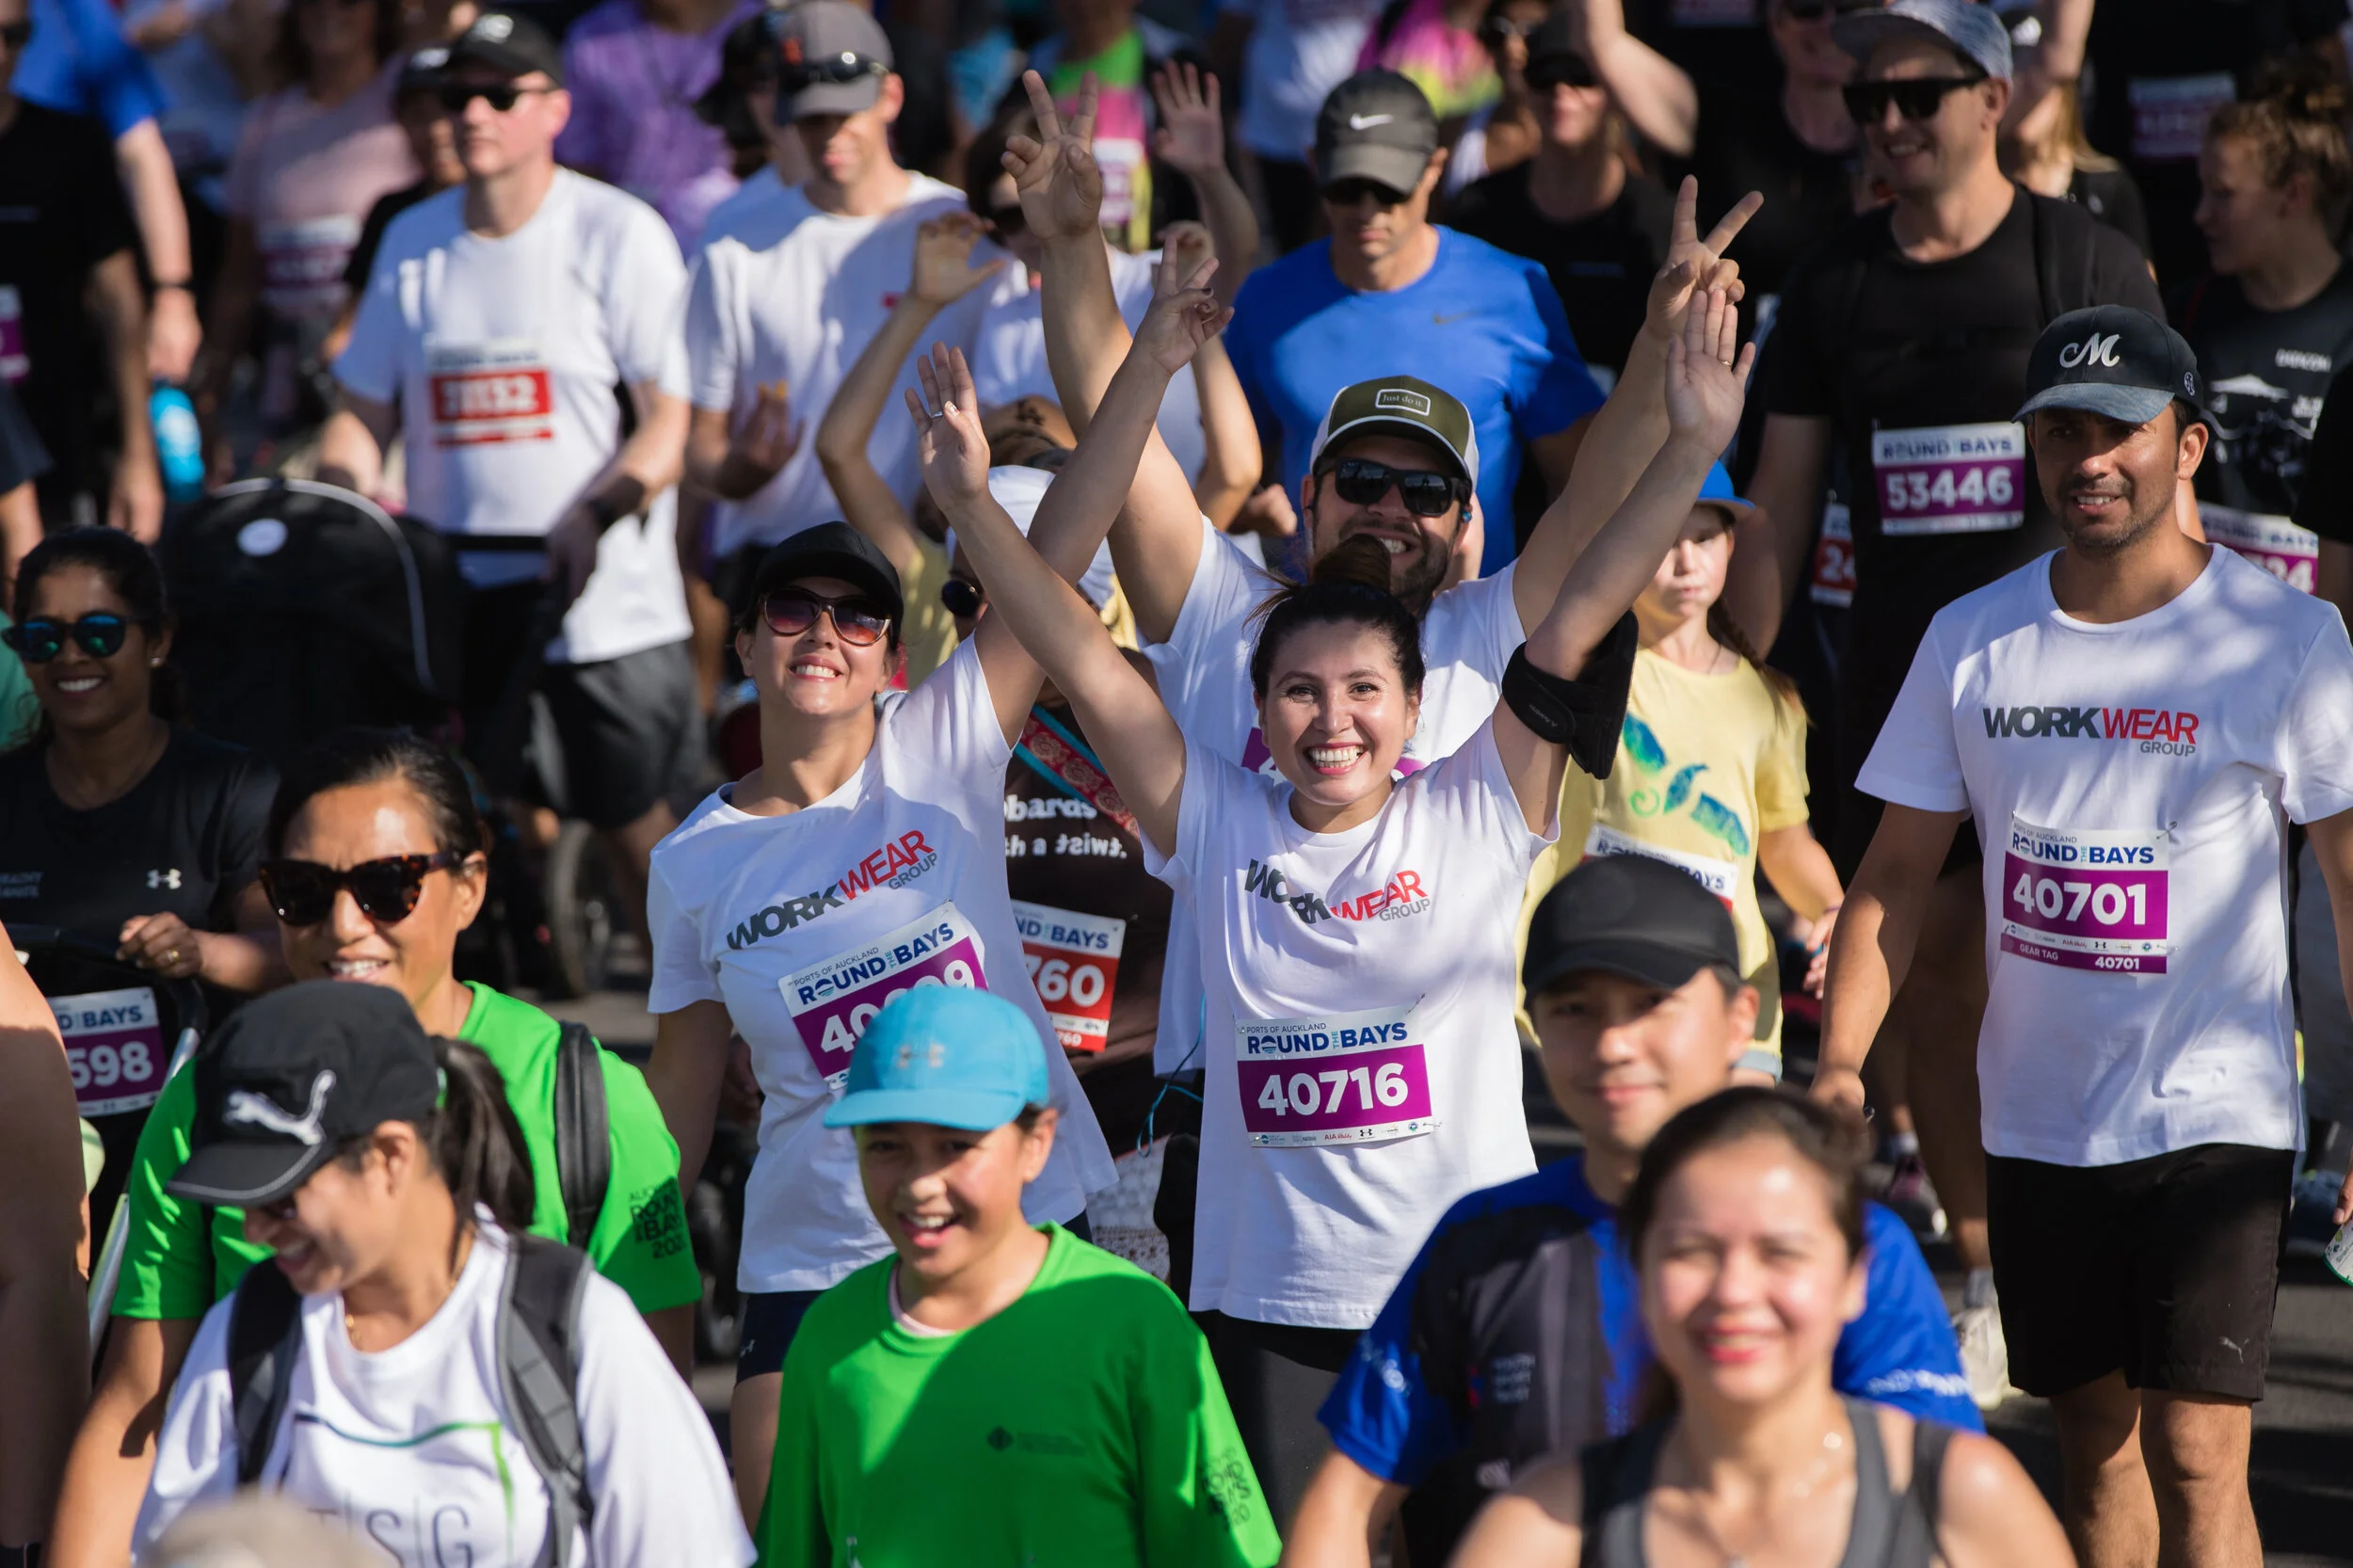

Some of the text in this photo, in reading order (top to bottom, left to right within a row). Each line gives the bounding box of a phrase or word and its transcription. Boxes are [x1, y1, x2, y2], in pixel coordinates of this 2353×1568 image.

[1383, 394, 1401, 403] Just
[1401, 395, 1414, 404] do
[1961, 437, 2013, 454] BAYS
[1885, 466, 2014, 512] 53446
[1982, 706, 2200, 744] WORKWEAR
[2139, 741, 2196, 757] GROUP
[1032, 838, 1047, 856] a
[2012, 832, 2078, 862] ROUND
[2089, 846, 2154, 864] BAYS
[2036, 832, 2077, 844] AUCKLAND
[888, 852, 938, 890] GROUP
[727, 829, 934, 951] WORKWEAR
[2012, 872, 2146, 926] 40701
[1379, 898, 1431, 922] GROUP
[1050, 923, 1111, 950] BAYS
[797, 956, 887, 1006] ROUND
[892, 922, 954, 966] BAYS
[2019, 943, 2059, 961] GEAR TAG
[2094, 956, 2140, 970] 40701
[793, 947, 879, 987] PORTS OF AUCKLAND
[83, 1005, 143, 1028] BAYS
[1246, 1022, 1327, 1034] PORTS OF AUCKLAND
[1247, 1032, 1330, 1055] ROUND
[1339, 1022, 1408, 1048] BAYS
[66, 1040, 154, 1090] 598
[1257, 1063, 1409, 1116] 40716
